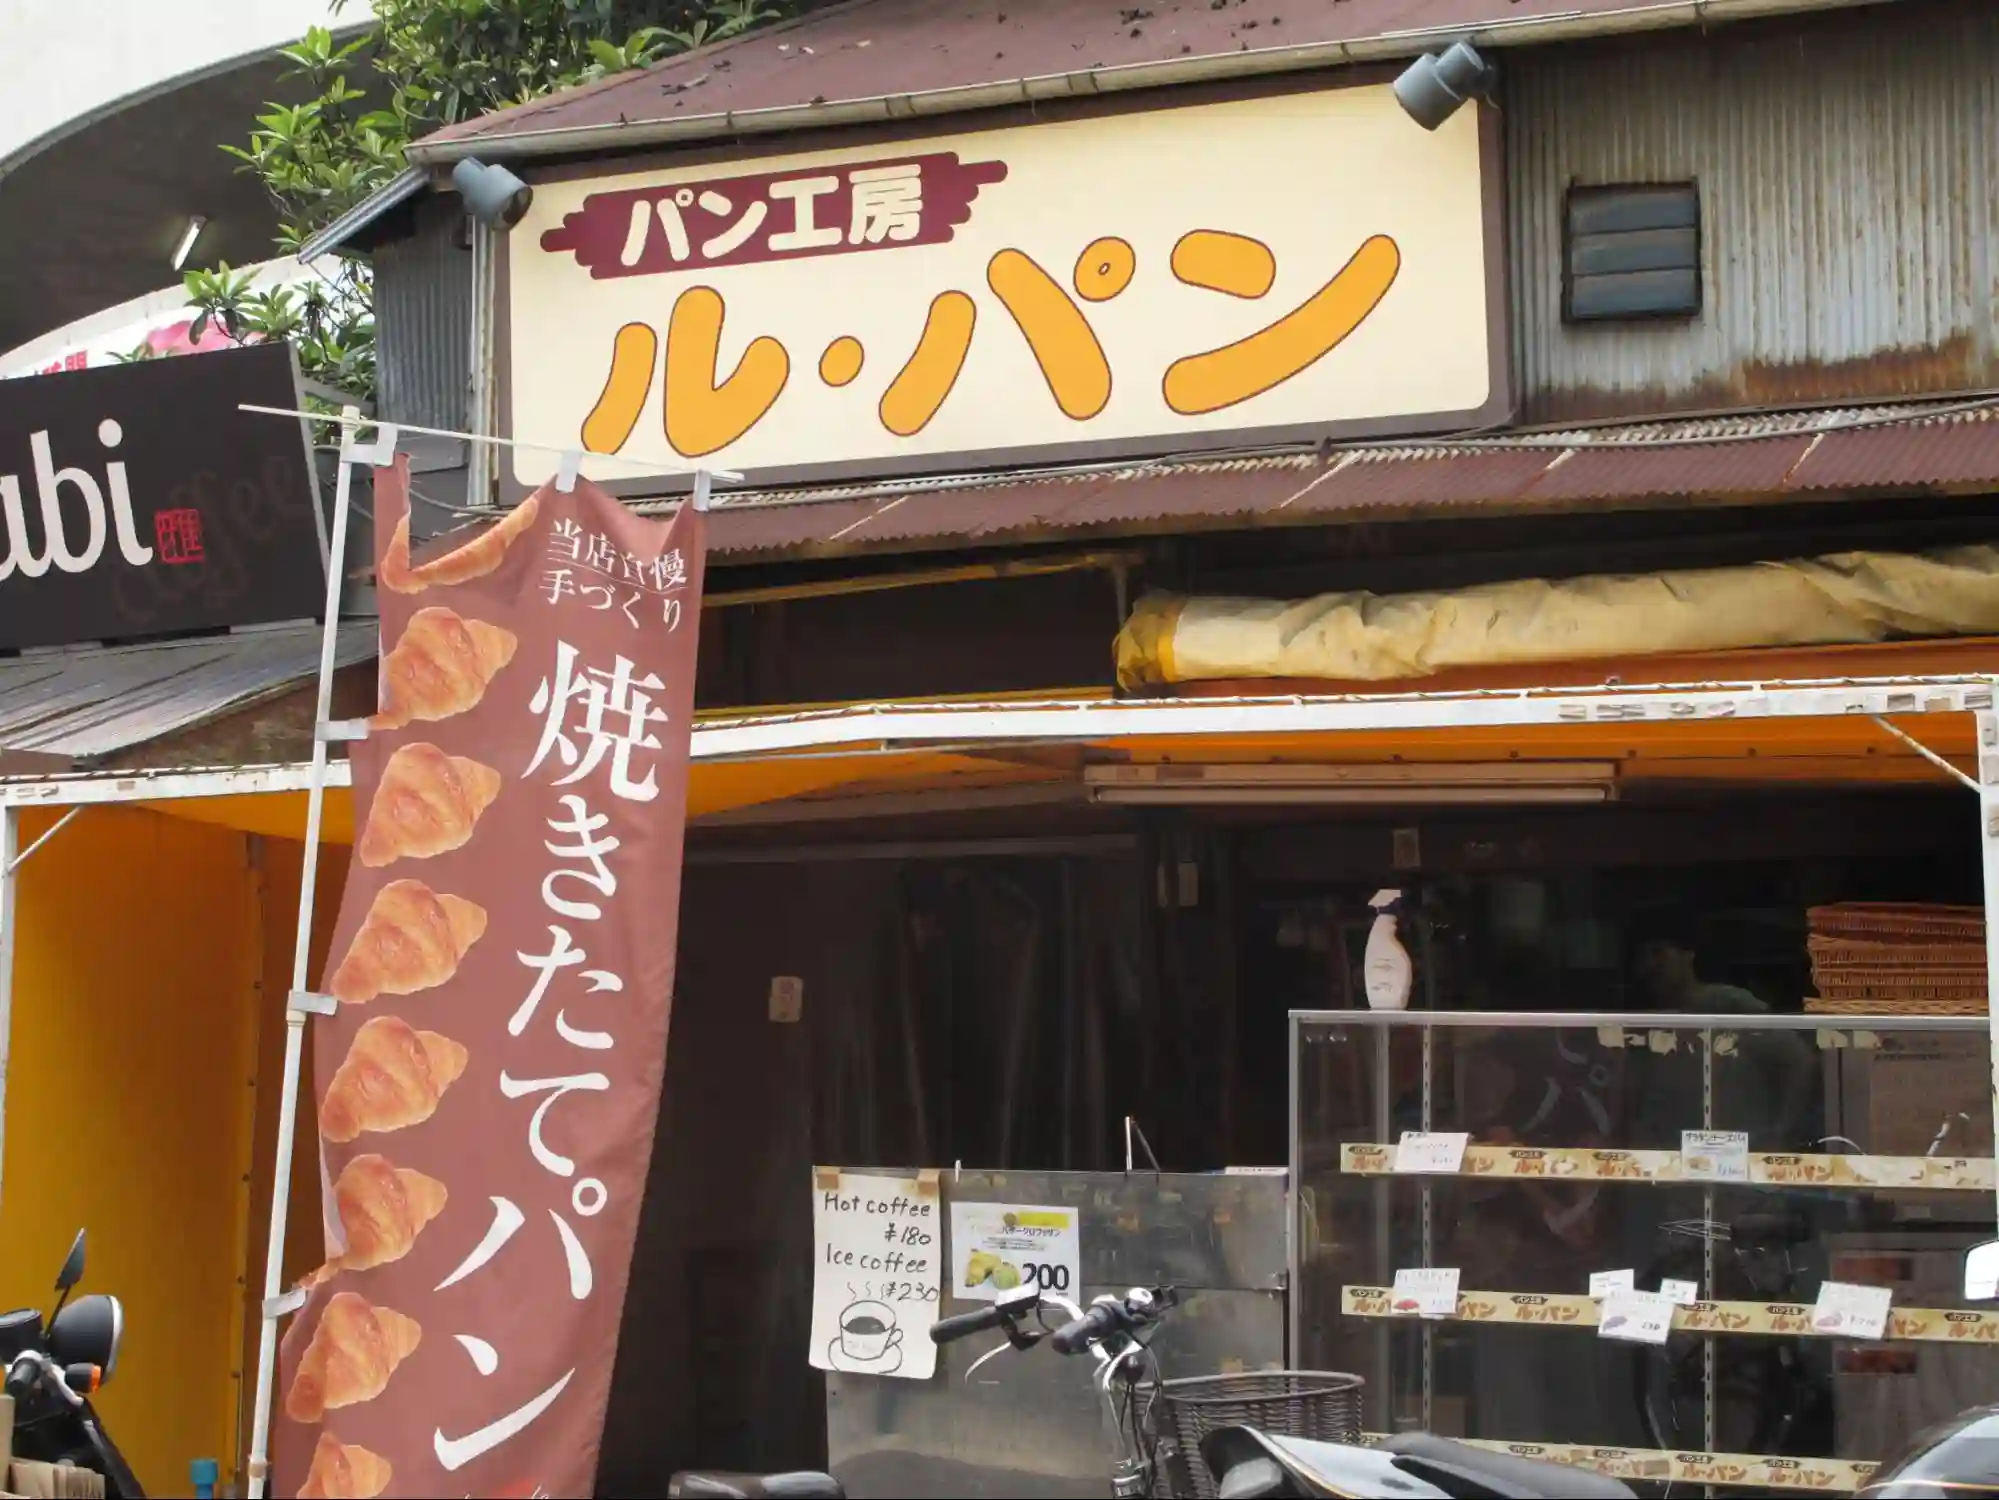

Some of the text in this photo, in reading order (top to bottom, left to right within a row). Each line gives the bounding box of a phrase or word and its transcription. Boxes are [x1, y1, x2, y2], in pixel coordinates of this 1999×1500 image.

[622, 162, 923, 267] パン工房
[580, 228, 1401, 458] ル・パン
[547, 517, 688, 592] 当店自慢
[539, 569, 681, 634] 手づくり
[432, 639, 670, 1473] 焼きたてパン
[824, 1192, 931, 1217] Hot coffee
[884, 1222, 932, 1246] ¥180
[826, 1243, 928, 1273] Ice coffee
[1022, 1262, 1070, 1291] 200
